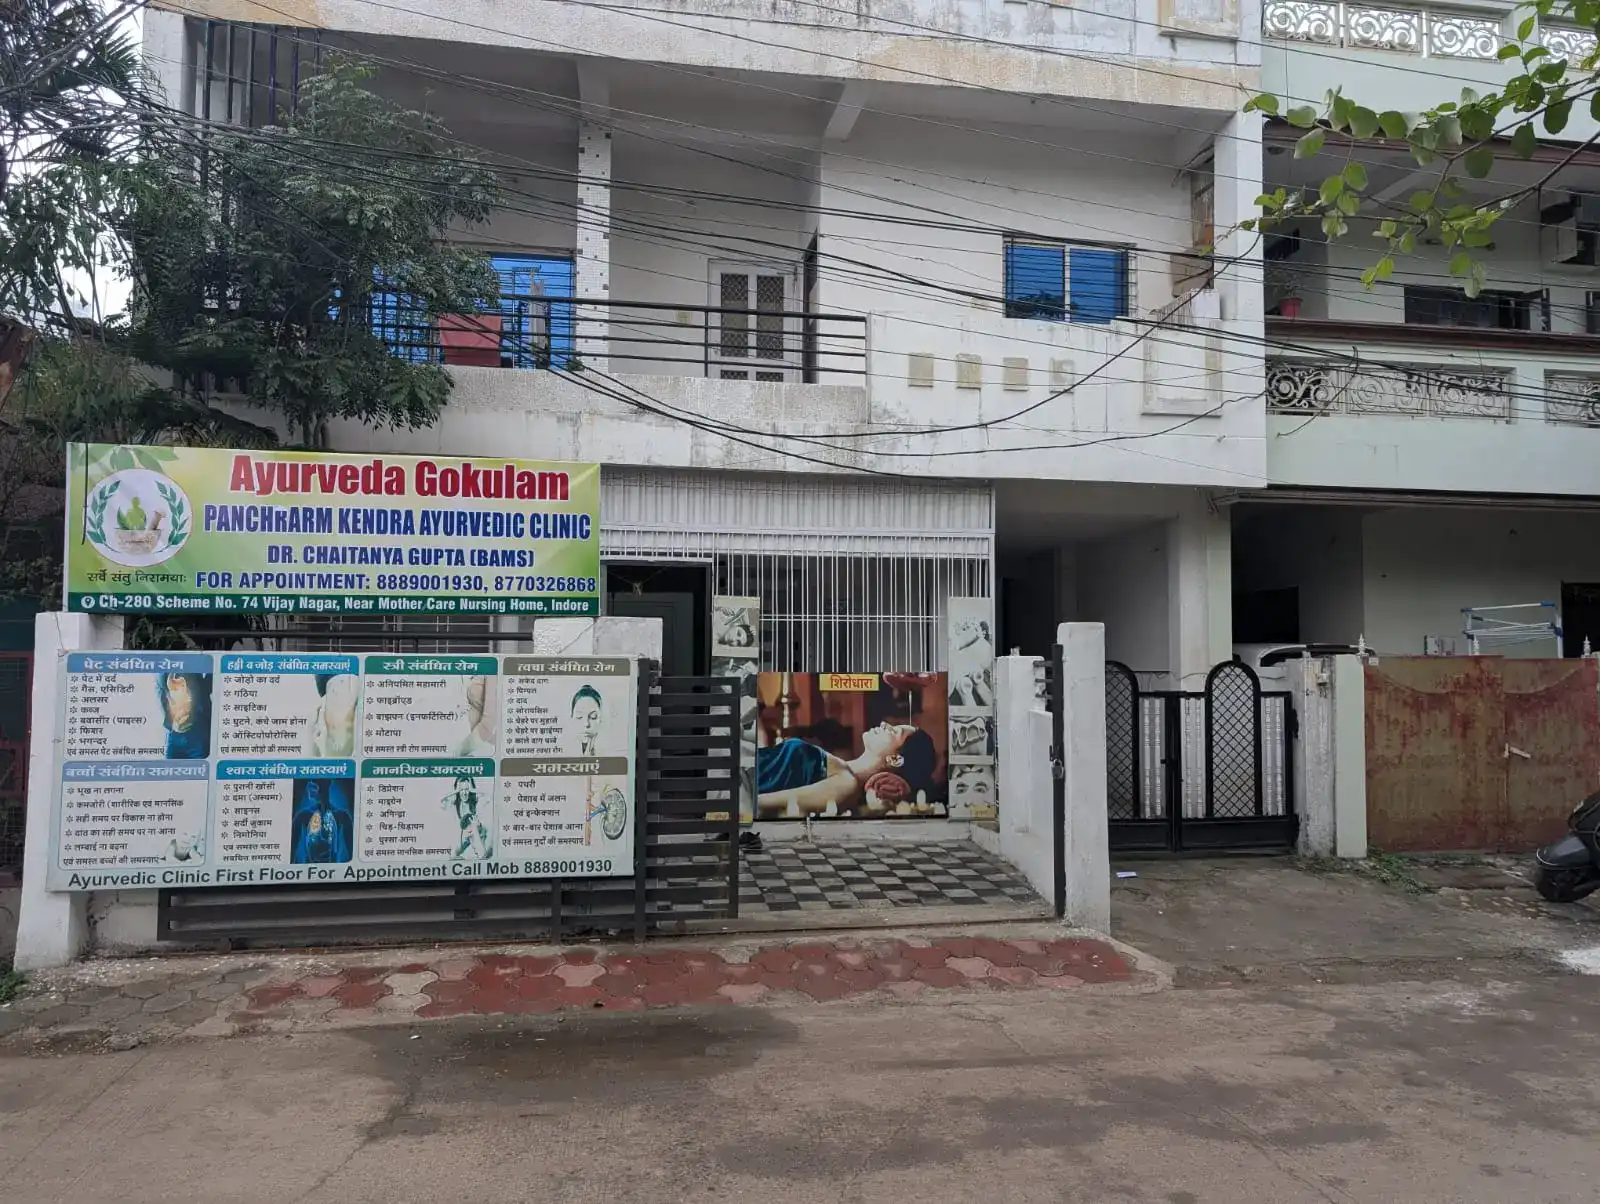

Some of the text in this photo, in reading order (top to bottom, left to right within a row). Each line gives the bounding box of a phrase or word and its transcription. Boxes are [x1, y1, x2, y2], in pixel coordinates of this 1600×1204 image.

[230, 455, 569, 500] Ayurveda Gokulam
[338, 507, 415, 535] KENDRA
[419, 510, 525, 538] AYURVEDIC
[529, 513, 591, 539] CLINIC
[268, 545, 535, 568] DR. CHAITANYA GUPTA (BAMS)
[87, 569, 107, 582] सर्वे
[111, 570, 131, 585] संतु
[196, 571, 596, 593] FOR APPOINTMENT: 8889001930, 8770326868
[99, 594, 589, 612] Ch-280 Scheme No. 74 Vijay Nagar, Near Mother Care Nursing Home, Indore
[84, 657, 184, 670] पेट संबंधित रोग
[278, 658, 309, 670] संबंधित
[383, 659, 478, 671] स्त्री संबंधित रोग
[548, 661, 590, 672] संबंधित
[593, 662, 615, 672] रोग
[81, 673, 93, 682] पेट
[830, 675, 873, 688] शिरोधारा
[81, 696, 109, 704] अलसर
[99, 764, 145, 777] संबंधित
[149, 765, 207, 778] समस्याएं
[259, 763, 297, 775] संबंधित
[300, 763, 347, 776] समस्याएं
[373, 763, 483, 775] मानसिक समस्याएं
[532, 760, 600, 774] समस्याएं
[68, 859, 612, 889] Ayurvedic Clinic First Floor For Appointment Call Mob 8889001930
